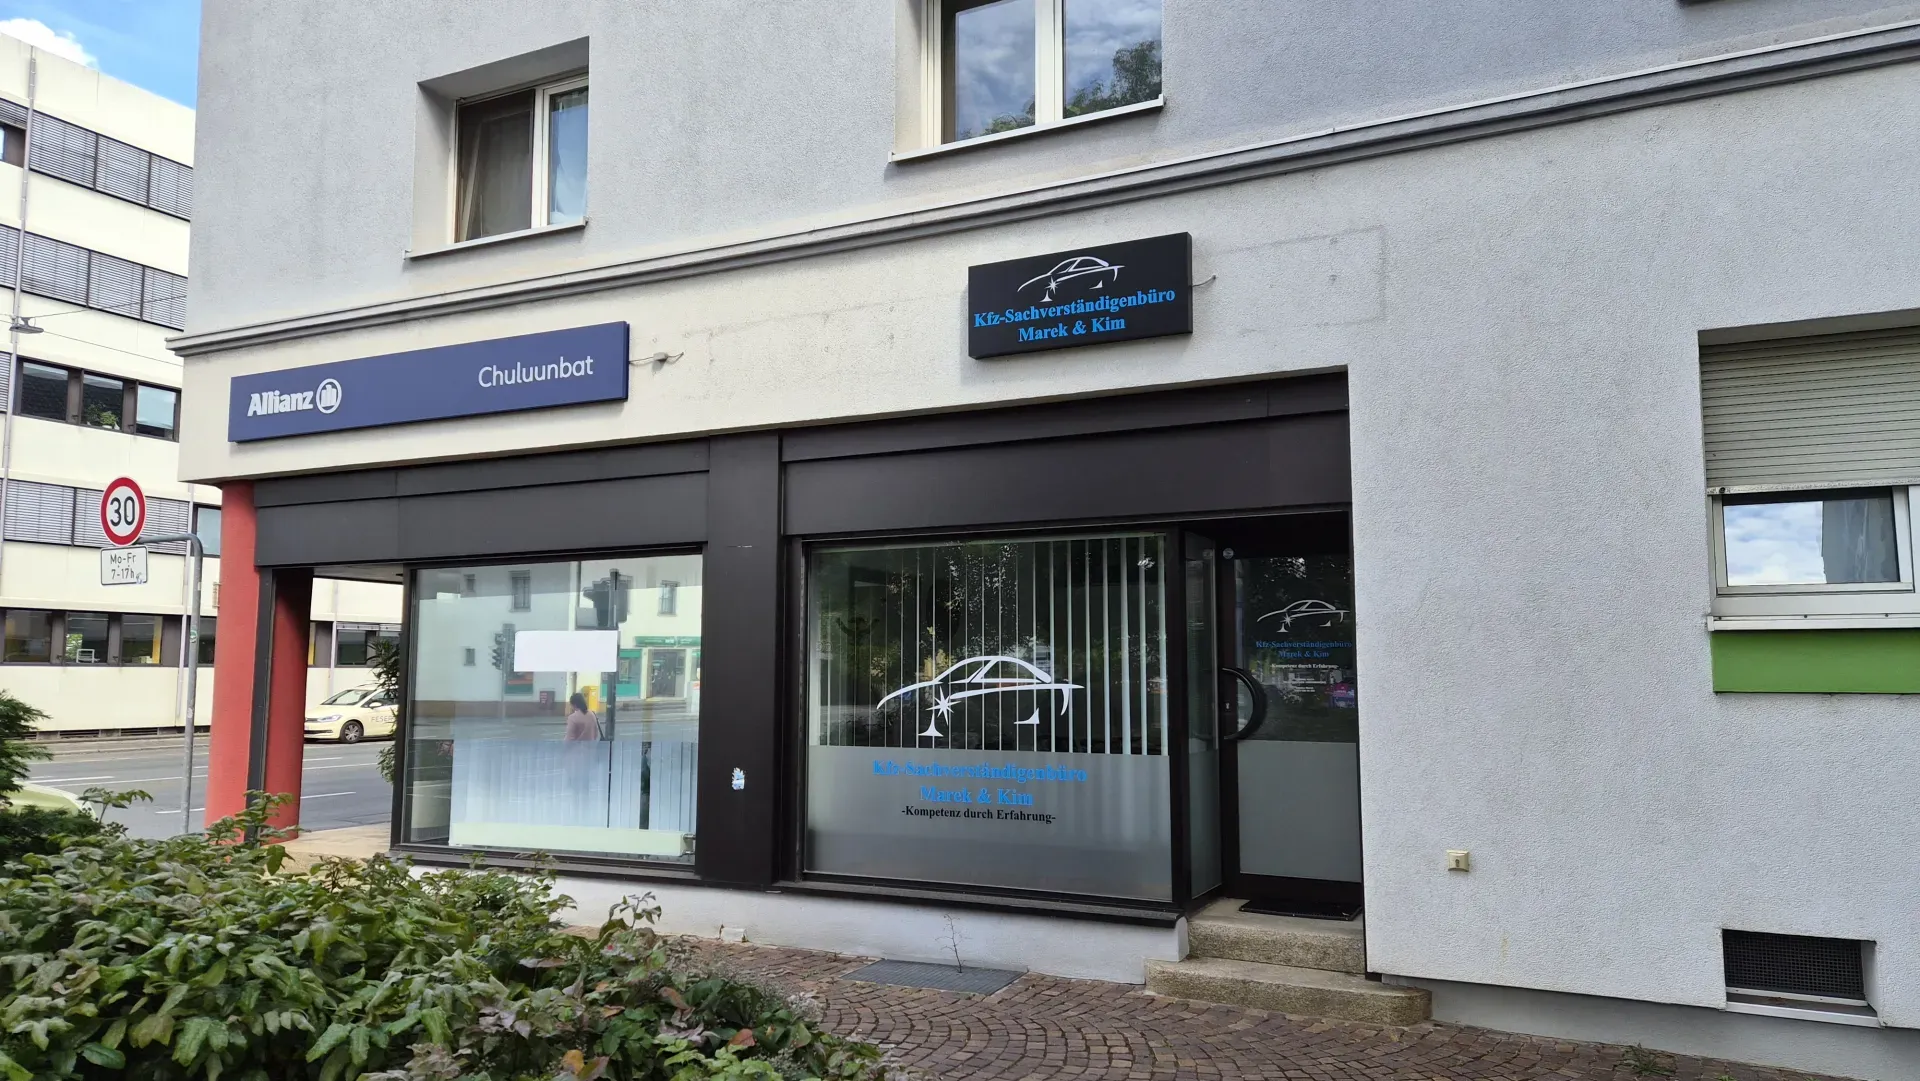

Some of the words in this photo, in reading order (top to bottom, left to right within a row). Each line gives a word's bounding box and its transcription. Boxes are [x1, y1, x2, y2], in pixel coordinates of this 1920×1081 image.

[973, 289, 1176, 328] Kfz-Sachverständigenbüro
[1018, 325, 1068, 342] Marek
[1072, 320, 1087, 336] &
[1092, 316, 1126, 333] Kim
[247, 389, 314, 417] Allianz
[478, 355, 594, 388] Chuluunbat
[110, 496, 136, 527] 30
[110, 552, 136, 565] Mo-Fr
[872, 760, 1088, 783] Kfz-Sachverständigenbüro
[920, 786, 972, 803] Marek
[977, 788, 992, 804] &
[998, 788, 1034, 806] Kim
[901, 806, 961, 819] -Kompetenz
[963, 808, 993, 820] durch
[997, 810, 1056, 824] Erfahrung-
